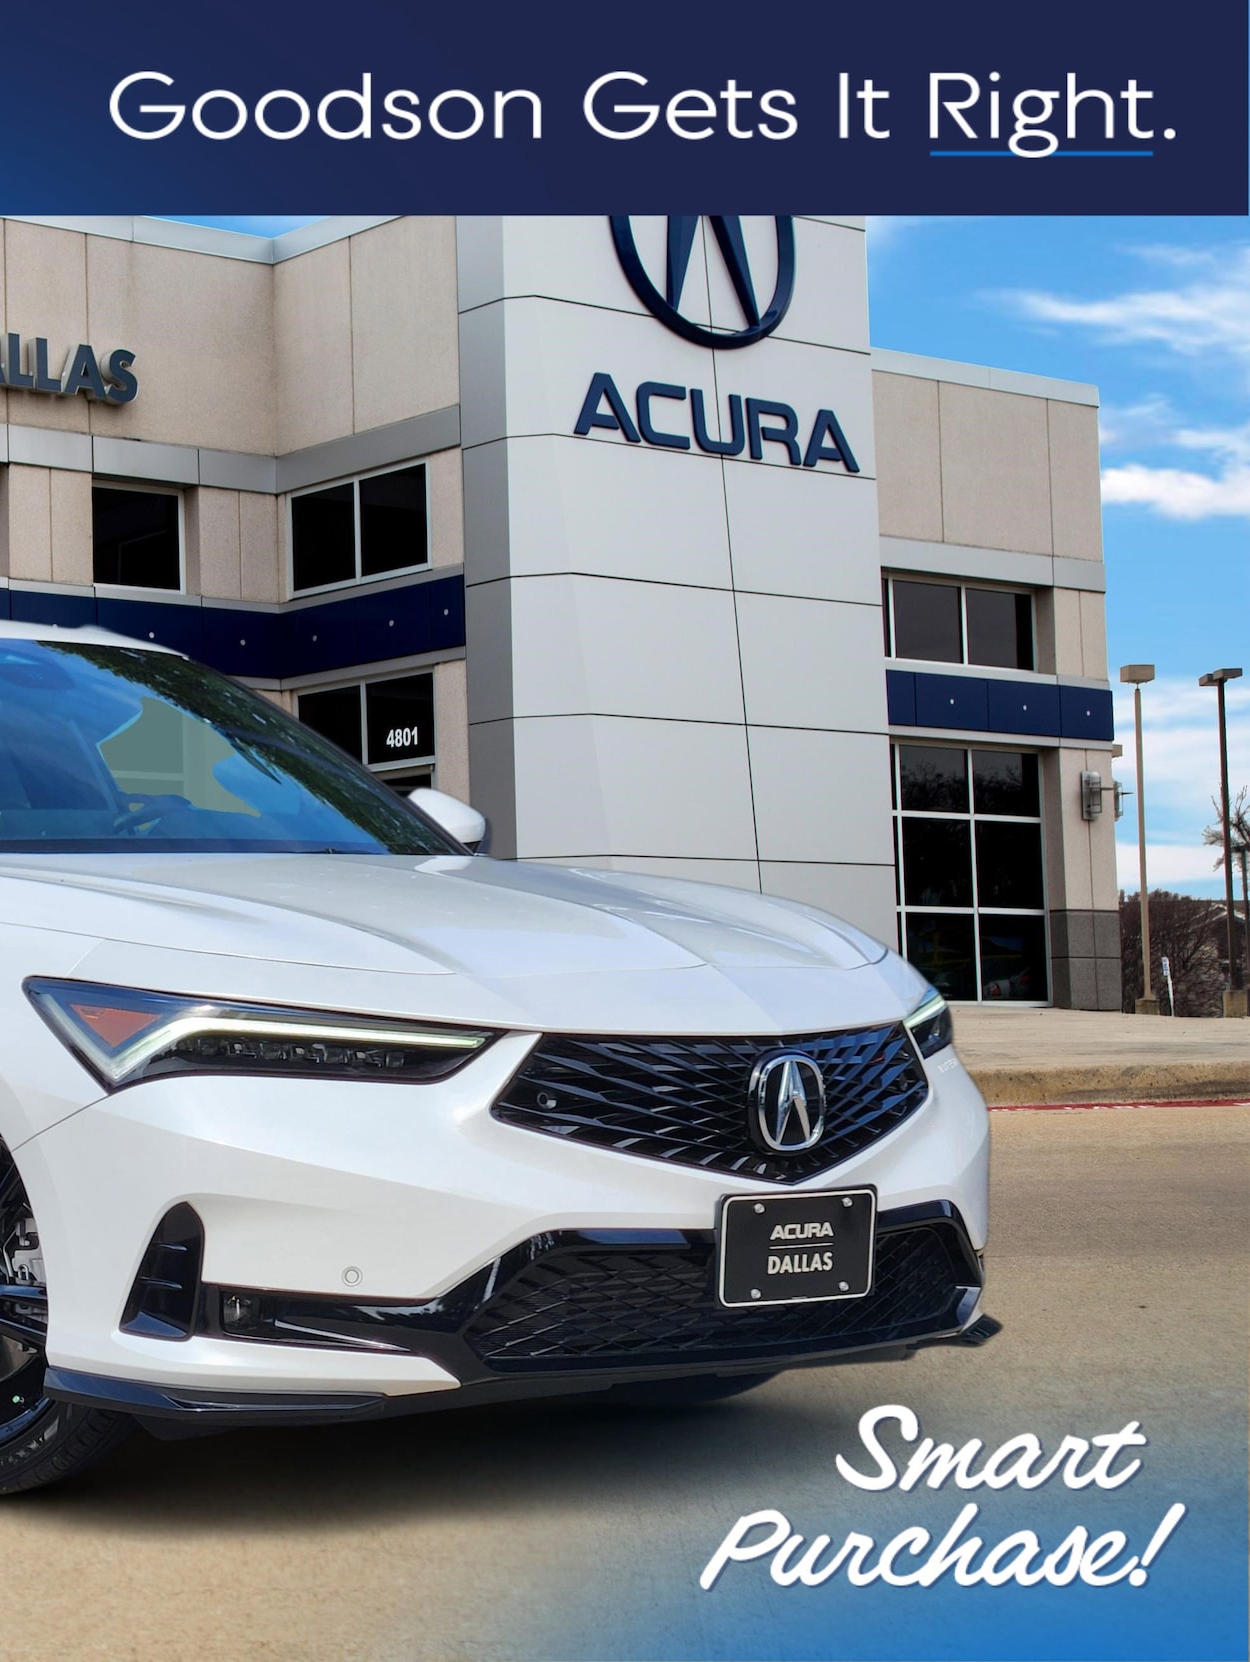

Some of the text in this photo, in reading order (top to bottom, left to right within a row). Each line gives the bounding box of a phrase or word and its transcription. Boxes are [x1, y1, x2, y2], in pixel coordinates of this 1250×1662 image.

[573, 372, 860, 473] ACURA
[386, 726, 418, 748] 4801
[770, 1222, 834, 1240] ACURA
[767, 1252, 833, 1275] DALLAS
